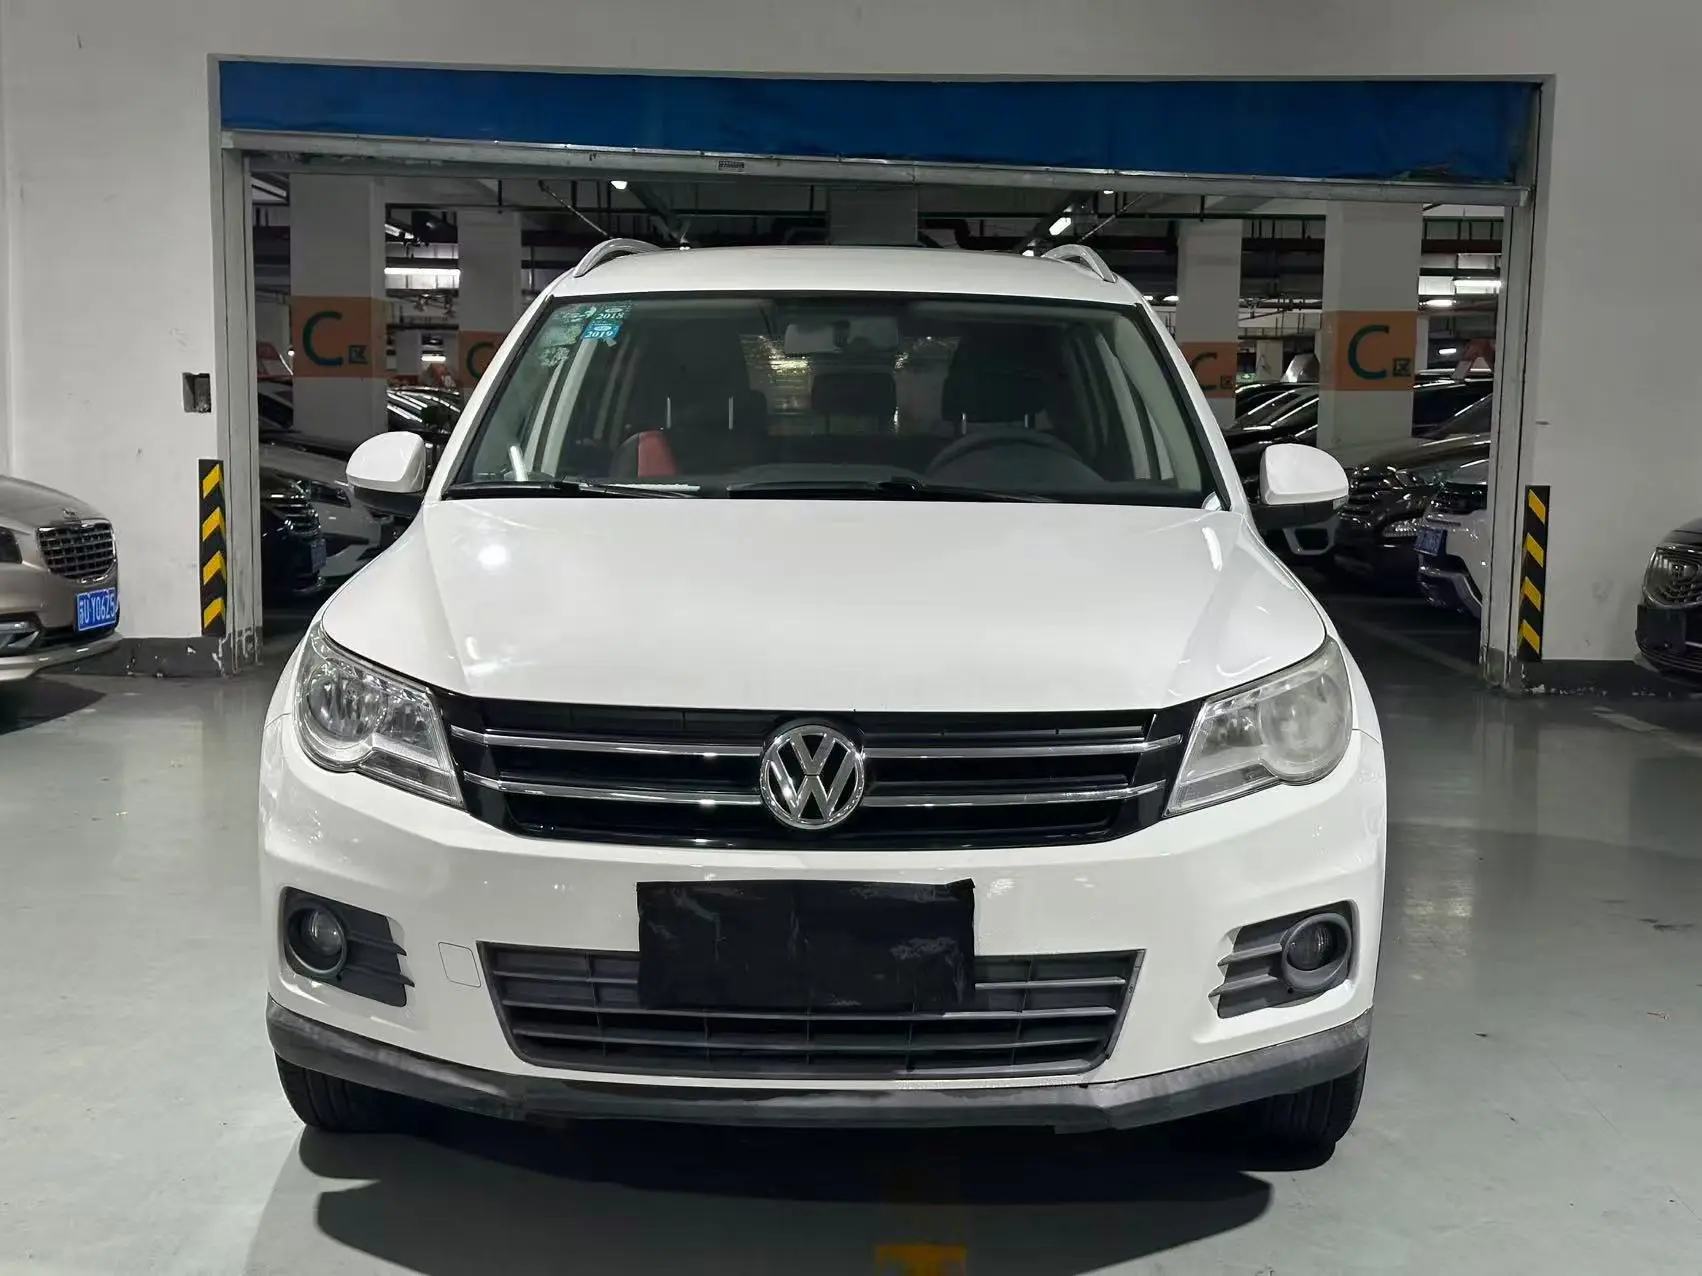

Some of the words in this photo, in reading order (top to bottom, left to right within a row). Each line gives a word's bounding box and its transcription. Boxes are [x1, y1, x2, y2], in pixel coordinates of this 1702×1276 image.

[595, 311, 625, 320] 2018
[584, 330, 614, 338] 2019
[762, 727, 862, 827] VW
